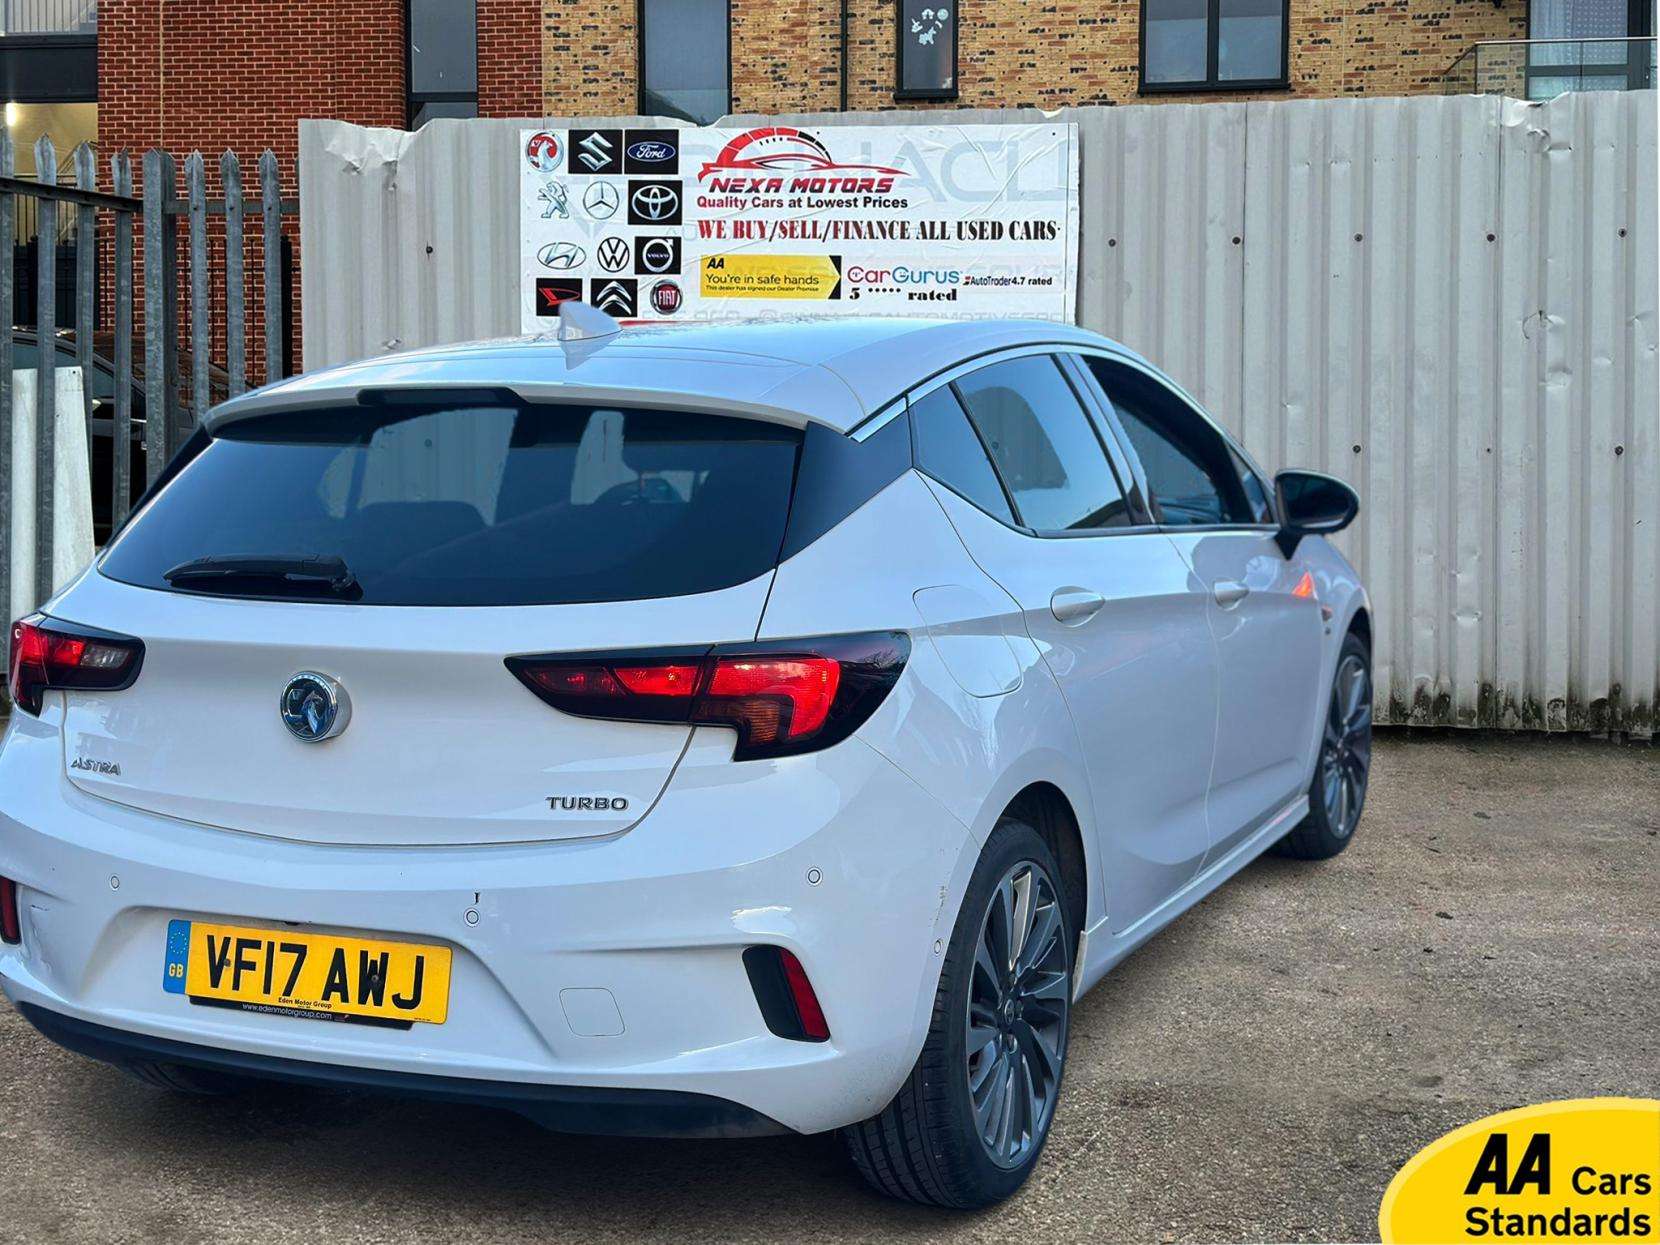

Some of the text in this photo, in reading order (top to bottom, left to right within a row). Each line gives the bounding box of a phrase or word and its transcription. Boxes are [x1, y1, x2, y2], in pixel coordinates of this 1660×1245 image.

[637, 144, 665, 158] Ford
[709, 178, 895, 193] NEXA MOTORS
[697, 196, 908, 211] Quality Cars at Lowest Prices
[697, 220, 727, 240] WE
[733, 220, 911, 243] BUY/SELL/FINANCE
[915, 220, 951, 240] ALL
[956, 220, 1004, 240] USED
[1008, 220, 1057, 240] CARS
[707, 257, 725, 269] AA
[706, 273, 819, 285] You're in safe hands
[847, 266, 960, 284] CarGurus
[1028, 277, 1053, 285] rated
[658, 290, 677, 306] FIAT
[849, 287, 957, 301] 5 rated
[71, 757, 121, 776] ASTRA
[545, 796, 629, 811] TURBO
[169, 963, 184, 979] GB
[206, 934, 425, 1010] VF17 AWJ
[278, 997, 294, 1005] Eden
[294, 999, 313, 1007] Motor
[313, 1001, 333, 1010] Group
[242, 1003, 333, 1021] www.edenmotorgroup.com
